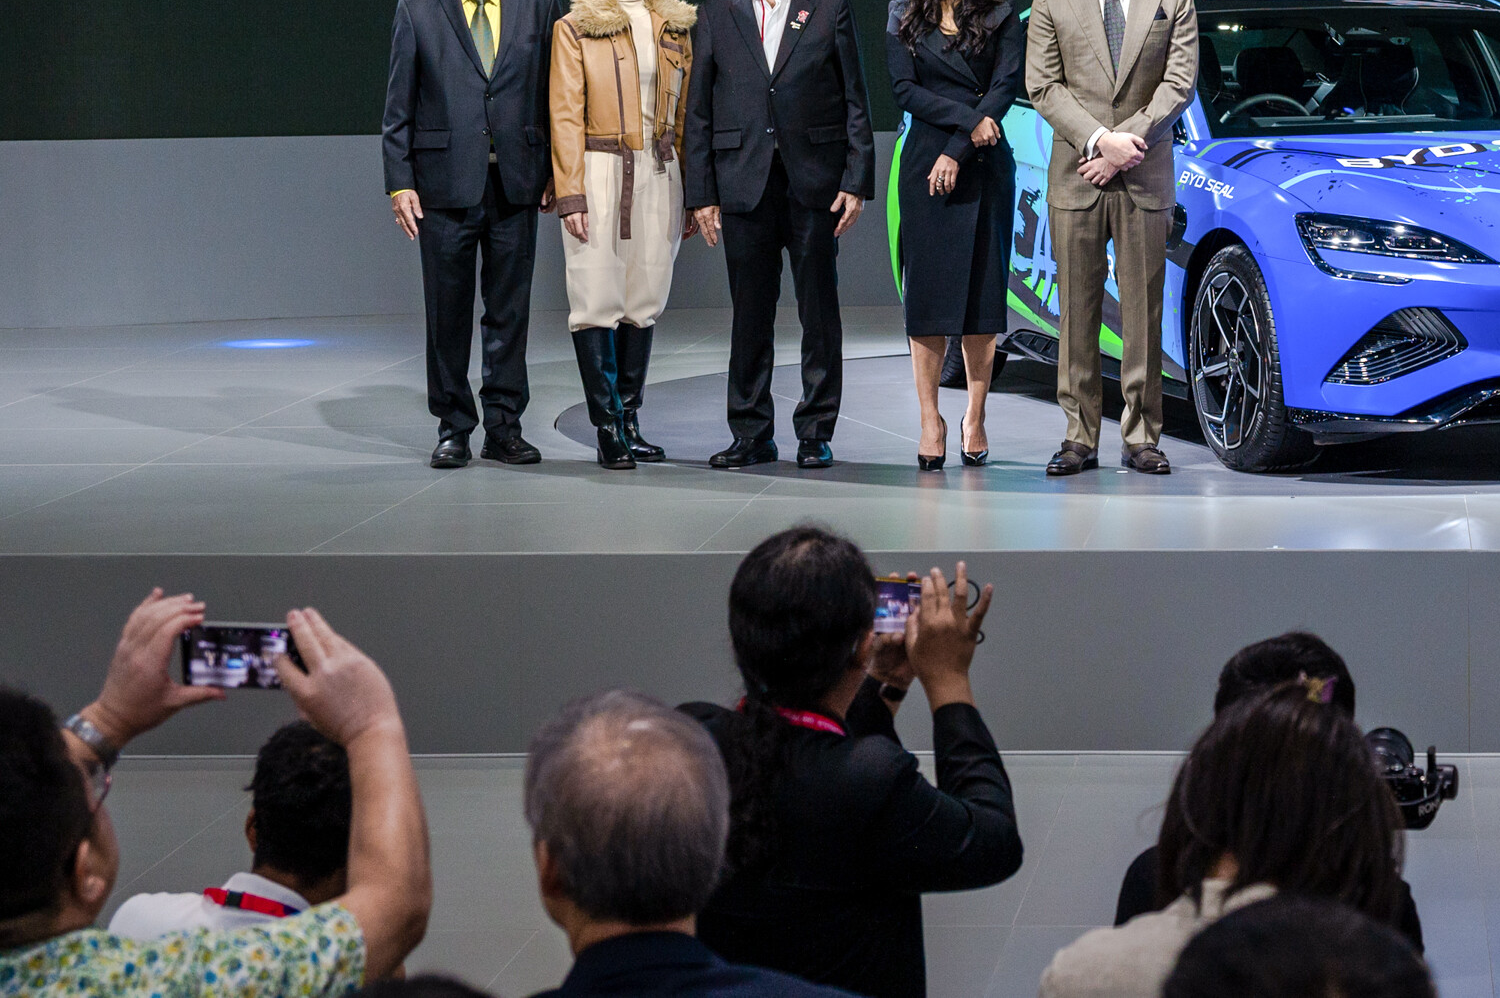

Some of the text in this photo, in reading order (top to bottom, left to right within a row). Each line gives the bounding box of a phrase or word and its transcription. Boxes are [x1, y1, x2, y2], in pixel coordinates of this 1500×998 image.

[1336, 142, 1478, 169] BYD
[1179, 170, 1235, 199] BYD SEAL
